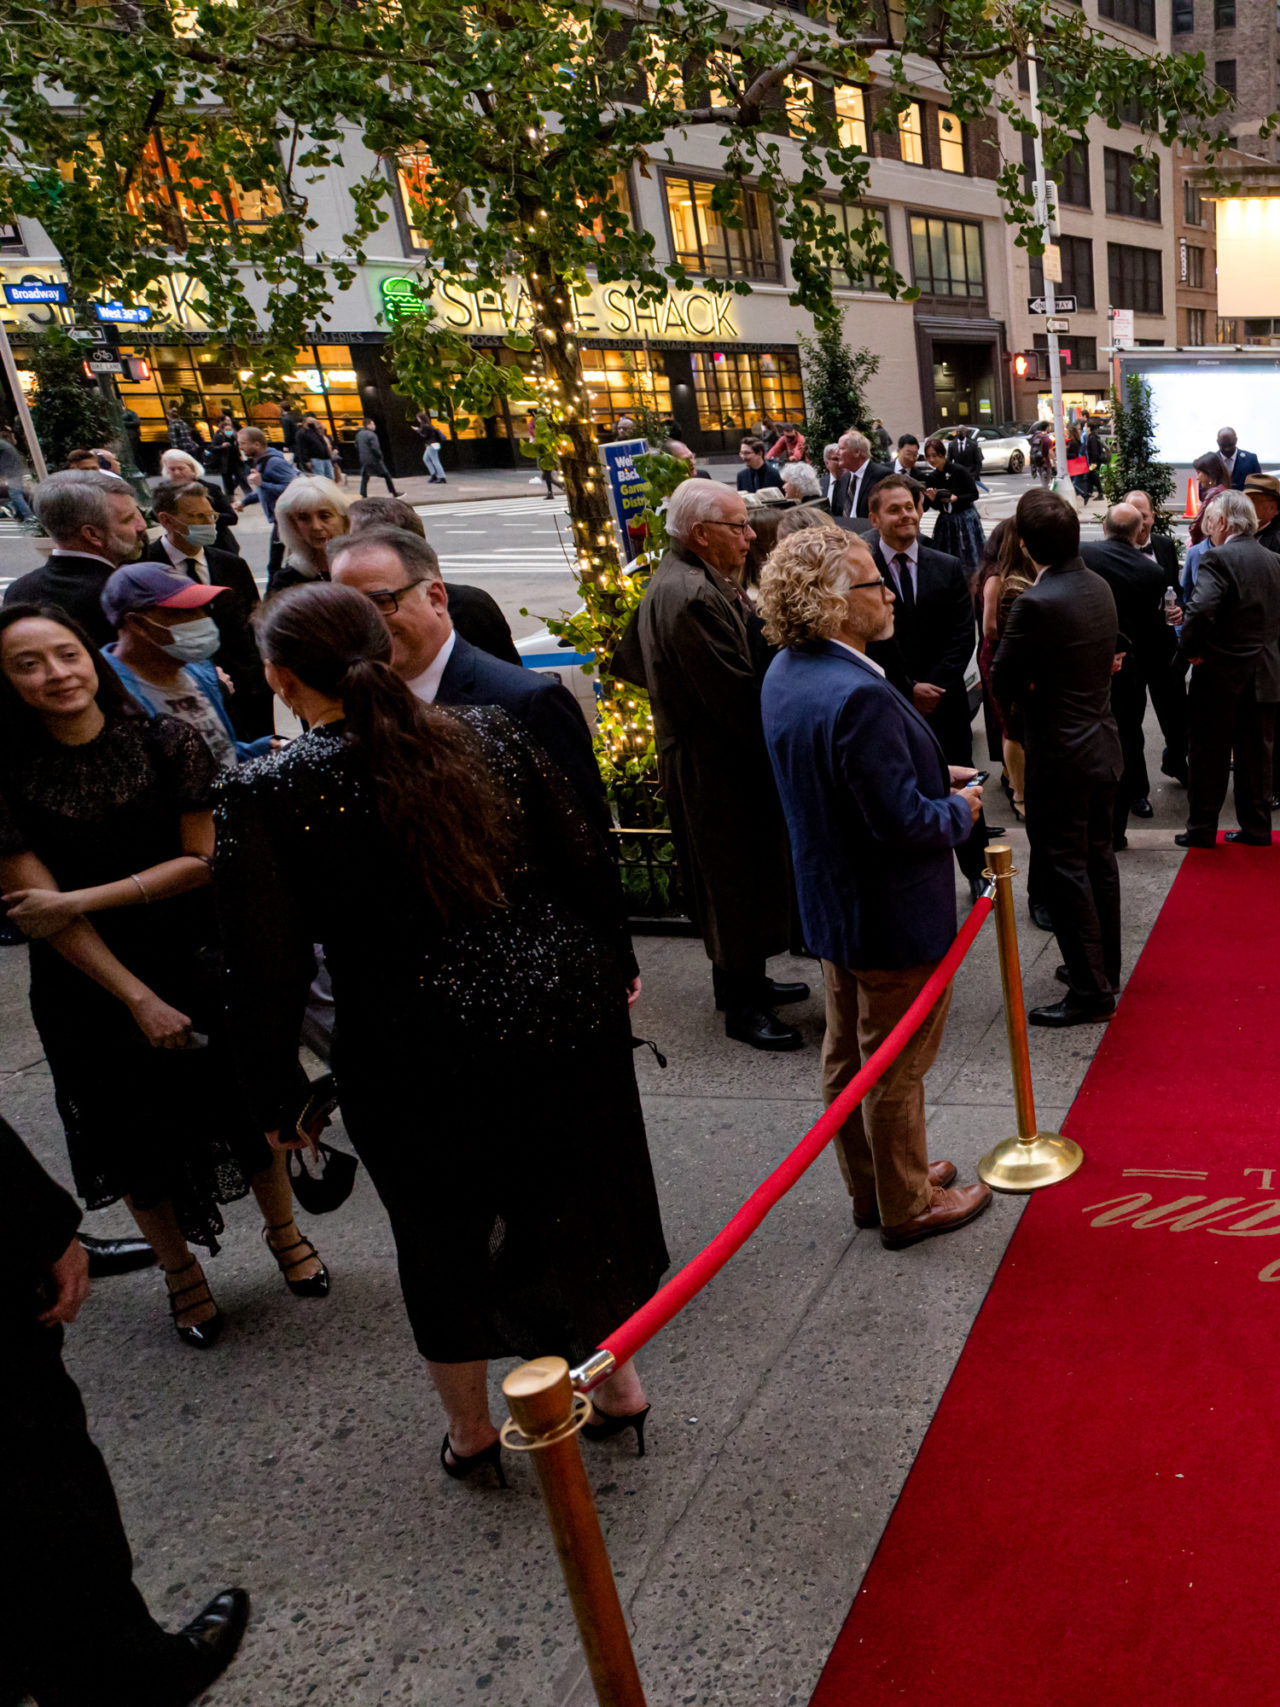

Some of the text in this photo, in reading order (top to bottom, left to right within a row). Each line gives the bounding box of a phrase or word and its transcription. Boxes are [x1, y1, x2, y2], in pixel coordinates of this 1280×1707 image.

[11, 288, 59, 301] Broadway
[98, 307, 121, 319] West
[437, 279, 738, 336] SHAE SHACK
[617, 468, 640, 482] Back
